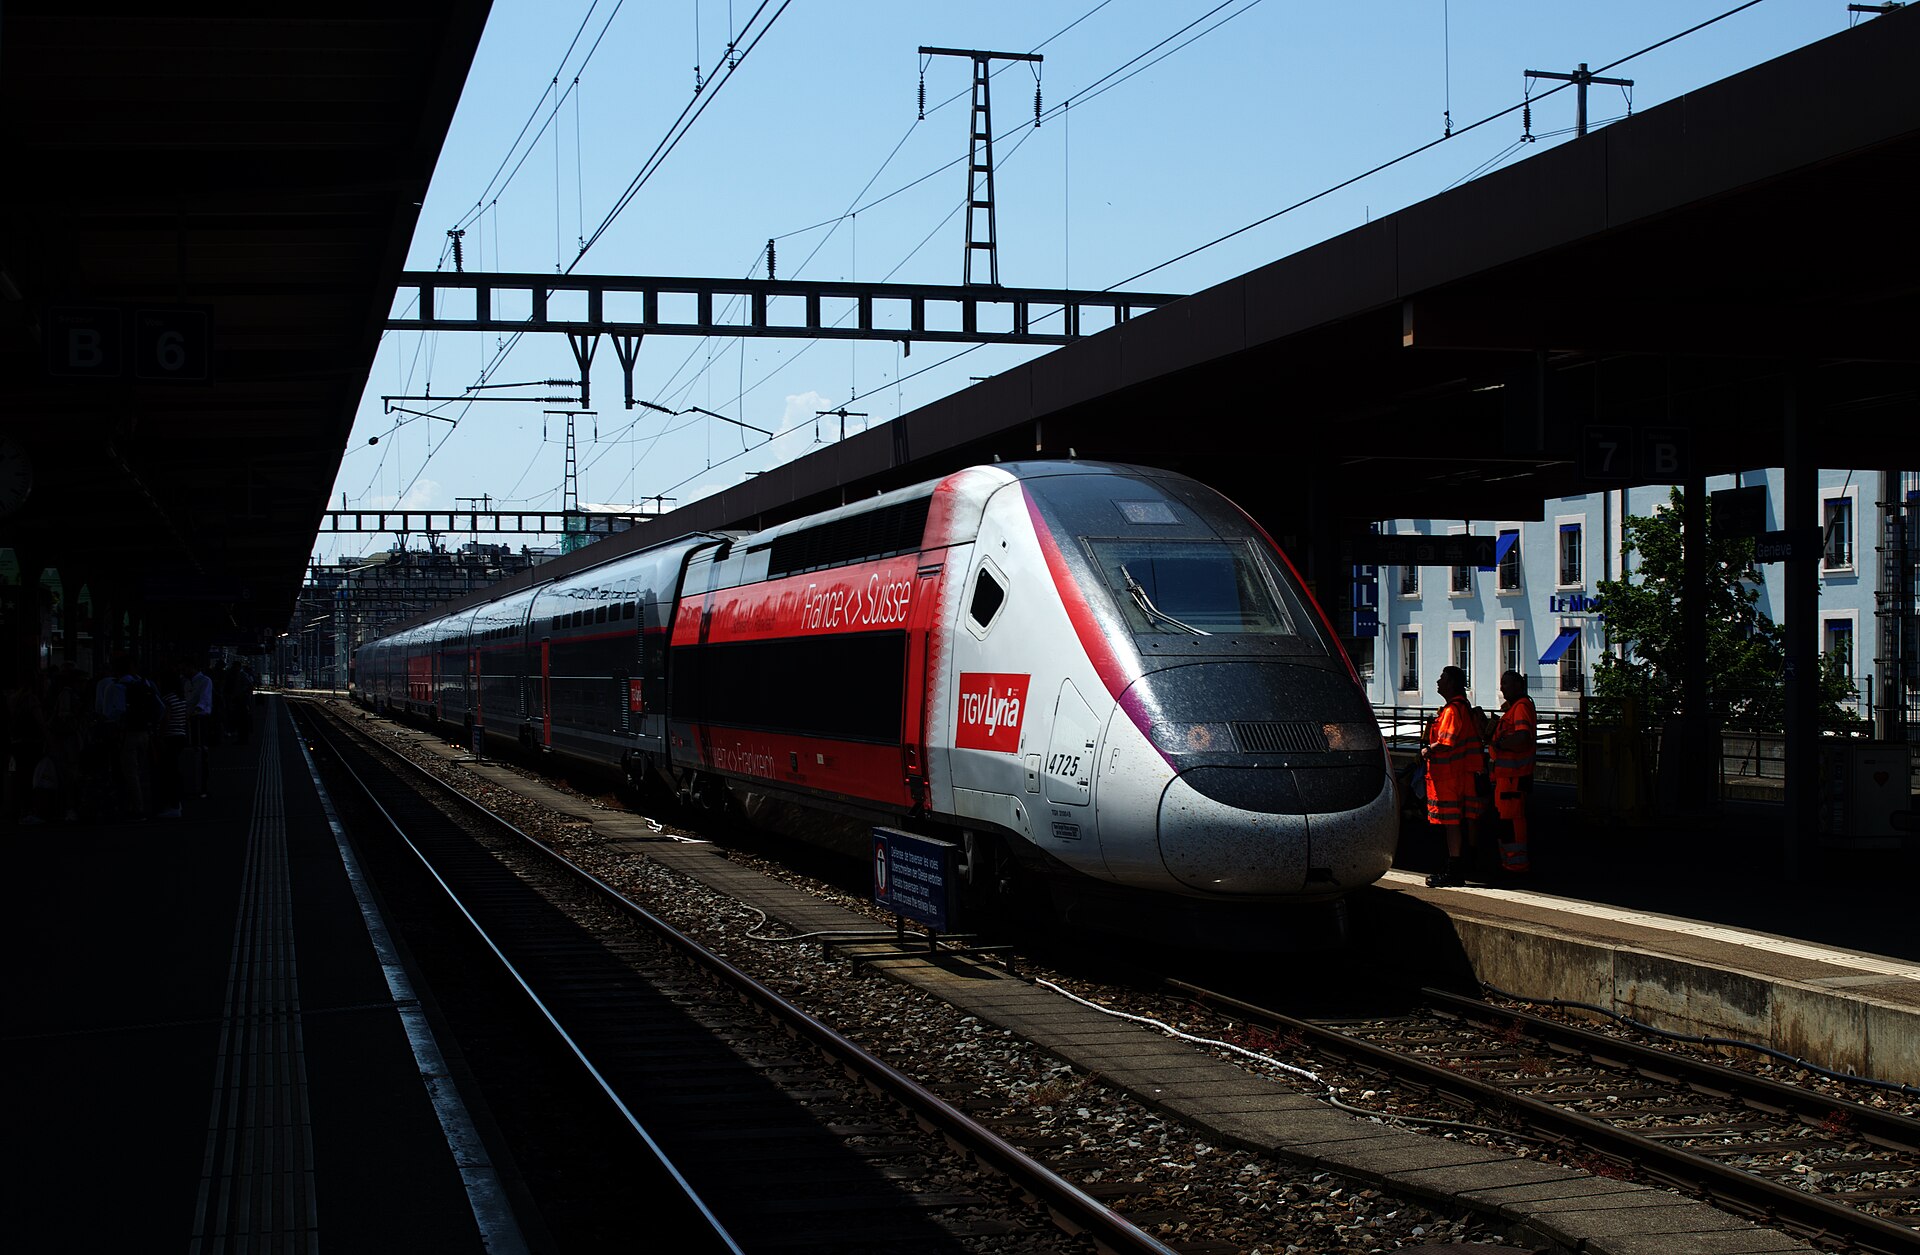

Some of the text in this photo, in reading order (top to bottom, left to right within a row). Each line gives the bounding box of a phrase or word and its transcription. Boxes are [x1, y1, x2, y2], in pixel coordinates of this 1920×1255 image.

[68, 328, 103, 368] B
[156, 330, 186, 371] 6
[1598, 441, 1618, 472] 7
[1655, 443, 1678, 473] B
[801, 583, 844, 630] France
[862, 569, 911, 625] Suisse
[962, 687, 1020, 737] TGV Lyria
[736, 742, 777, 779] Frankreich
[1048, 753, 1081, 777] 4725
